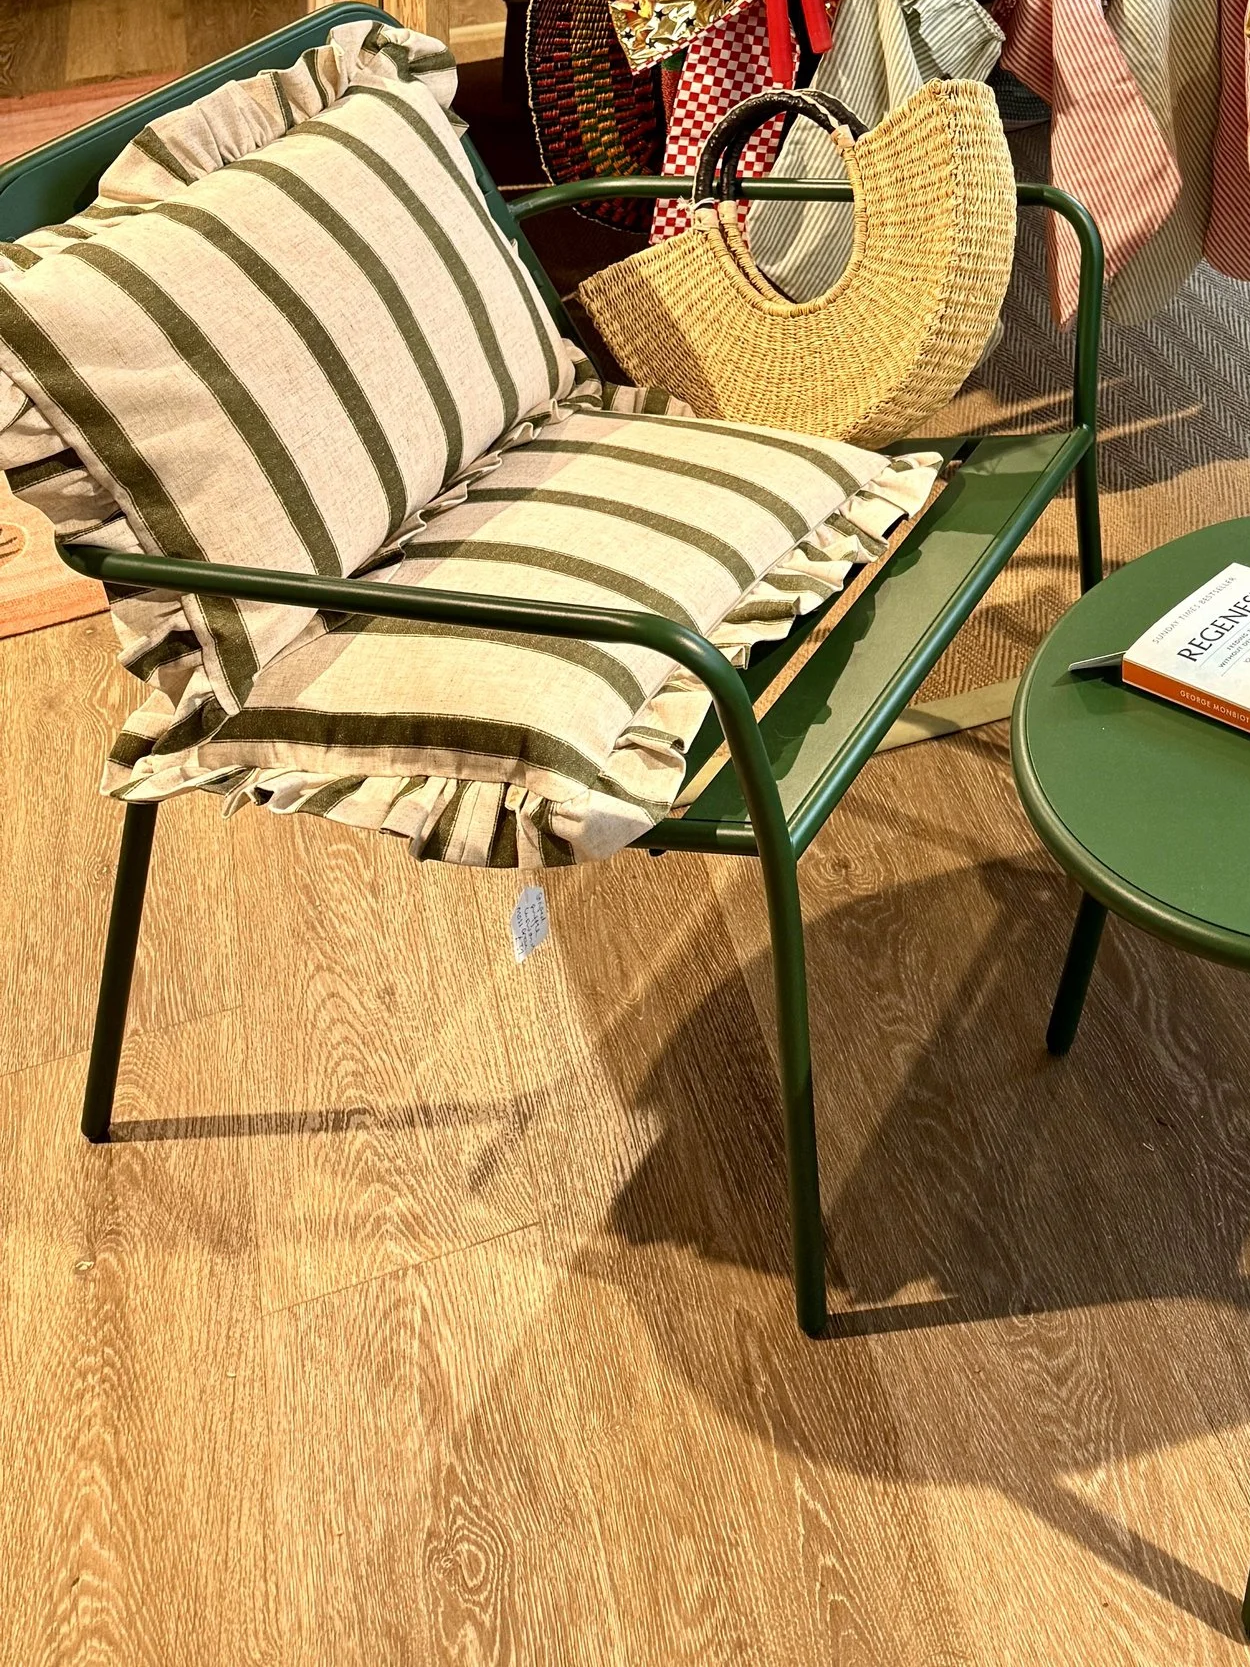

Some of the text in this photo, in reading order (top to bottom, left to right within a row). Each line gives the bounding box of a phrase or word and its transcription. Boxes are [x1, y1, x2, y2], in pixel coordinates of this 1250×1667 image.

[1152, 576, 1237, 645] SUNDAY TIMES BESTSELLER
[1218, 645, 1243, 669] WITHOUT
[1180, 689, 1211, 708] GEORGE
[1212, 703, 1250, 724] MONBIOT
